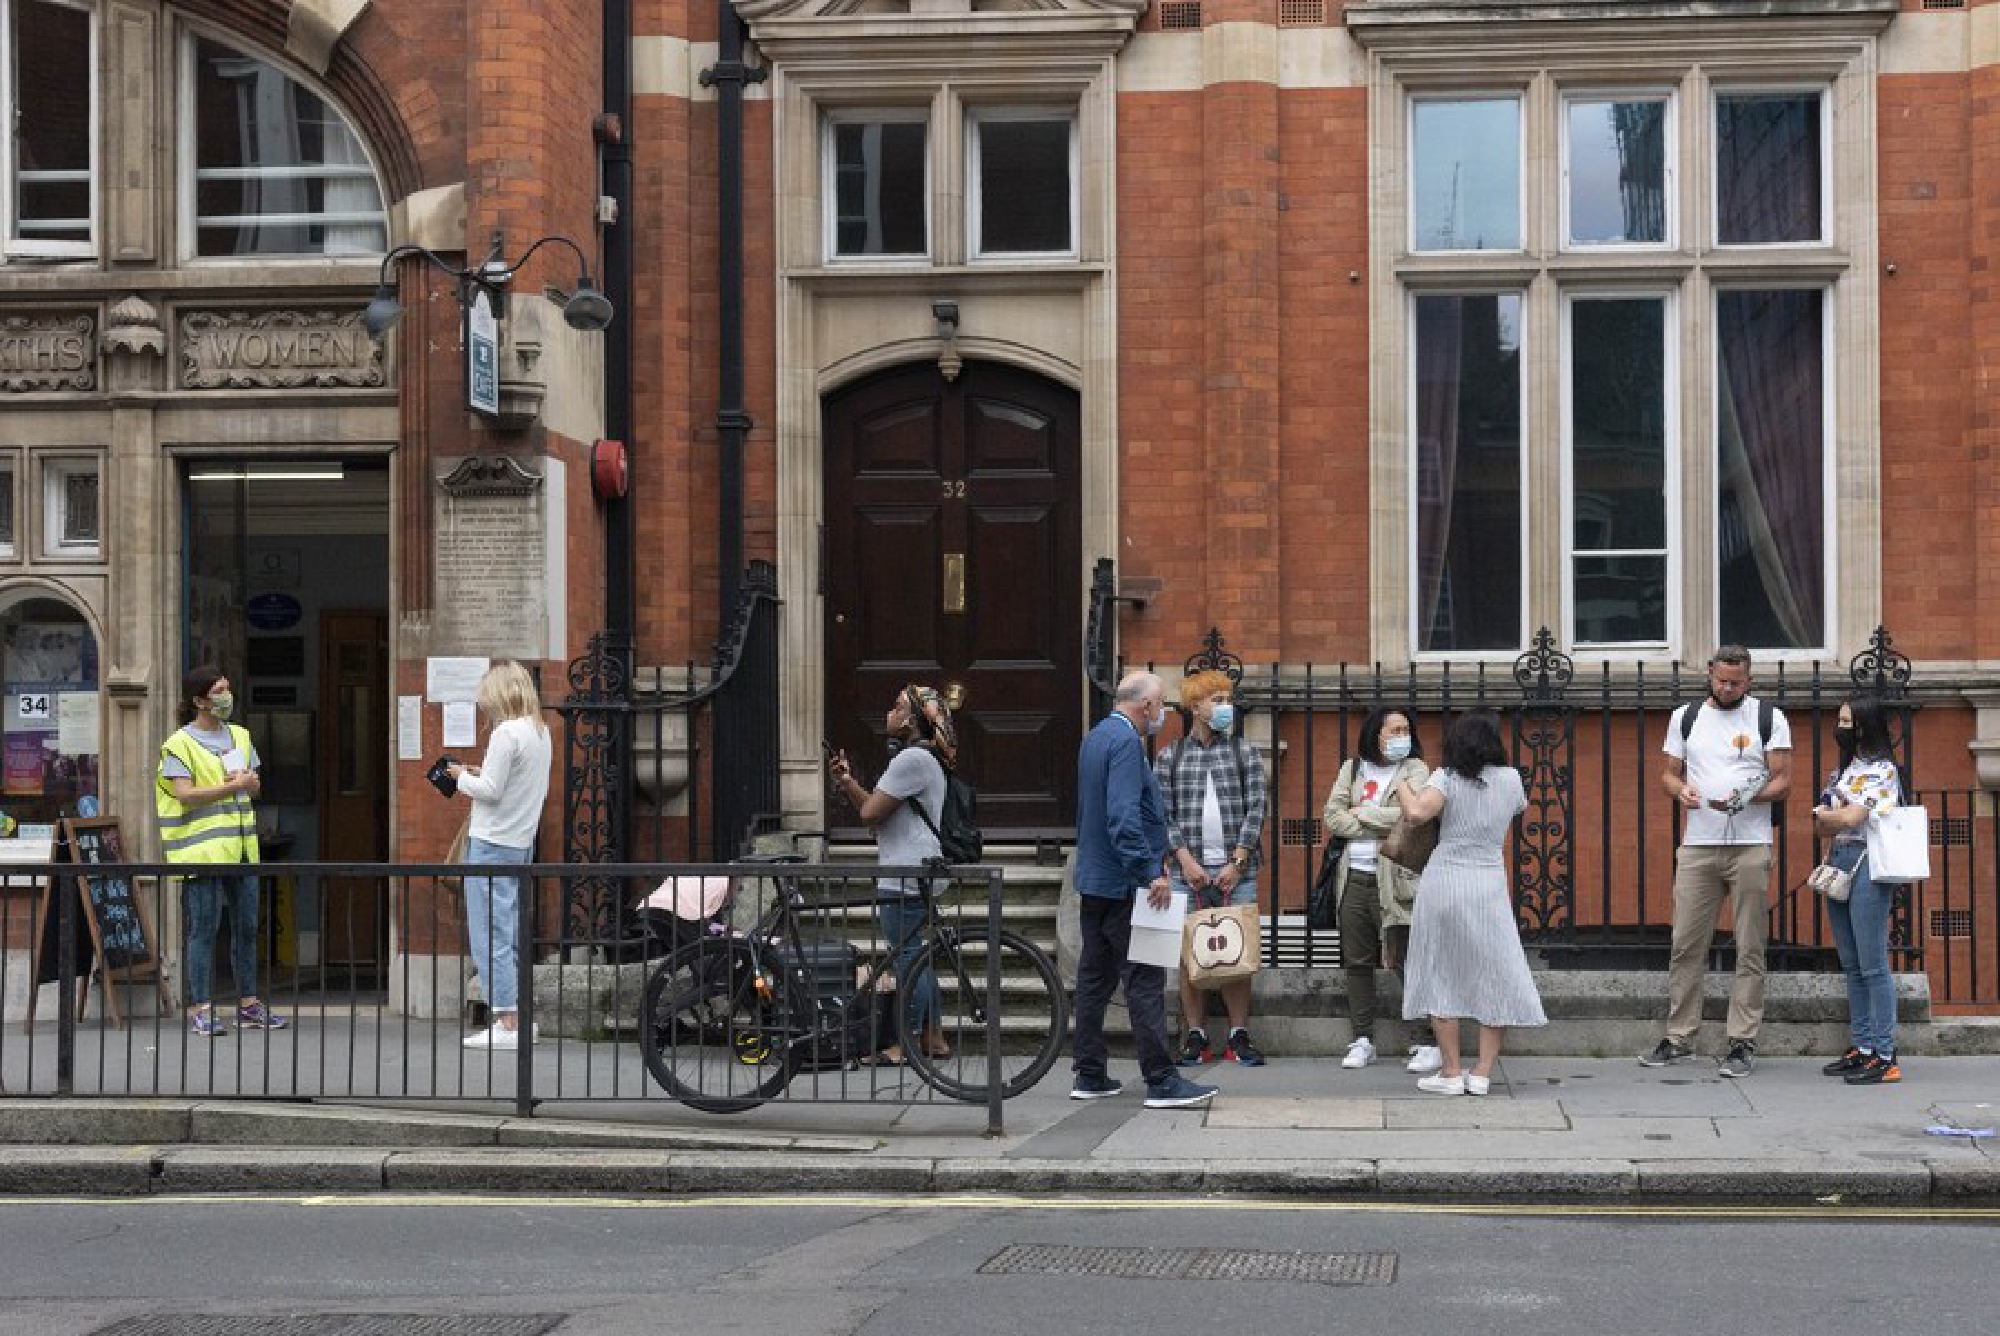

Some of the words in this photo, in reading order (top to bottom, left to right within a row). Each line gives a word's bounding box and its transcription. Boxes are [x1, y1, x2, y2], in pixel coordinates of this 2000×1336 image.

[208, 331, 359, 368] WOMEN
[942, 480, 965, 498] 32
[21, 696, 48, 714] 34
